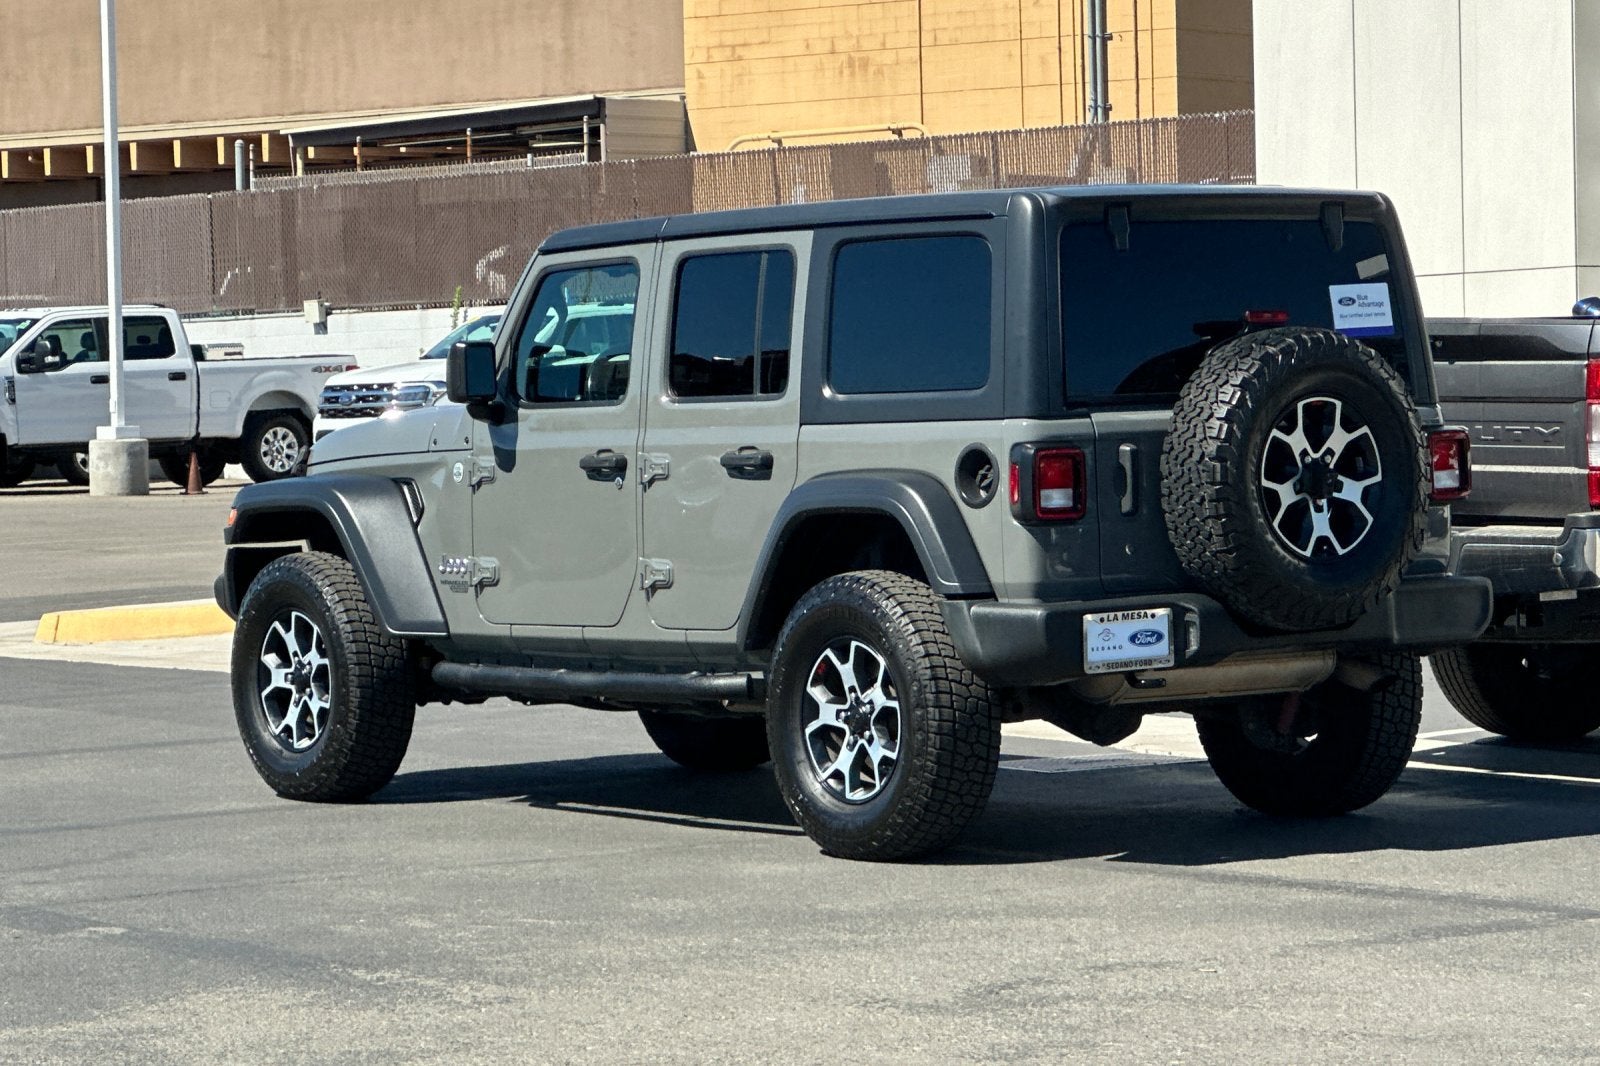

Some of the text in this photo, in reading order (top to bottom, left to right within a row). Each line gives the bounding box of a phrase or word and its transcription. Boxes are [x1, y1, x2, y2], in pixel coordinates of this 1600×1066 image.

[1474, 425, 1561, 443] UTY
[438, 553, 469, 578] Jeep
[1106, 611, 1149, 622] LA MESA
[1091, 644, 1123, 652] SEDANO
[1134, 659, 1153, 668] FORD
